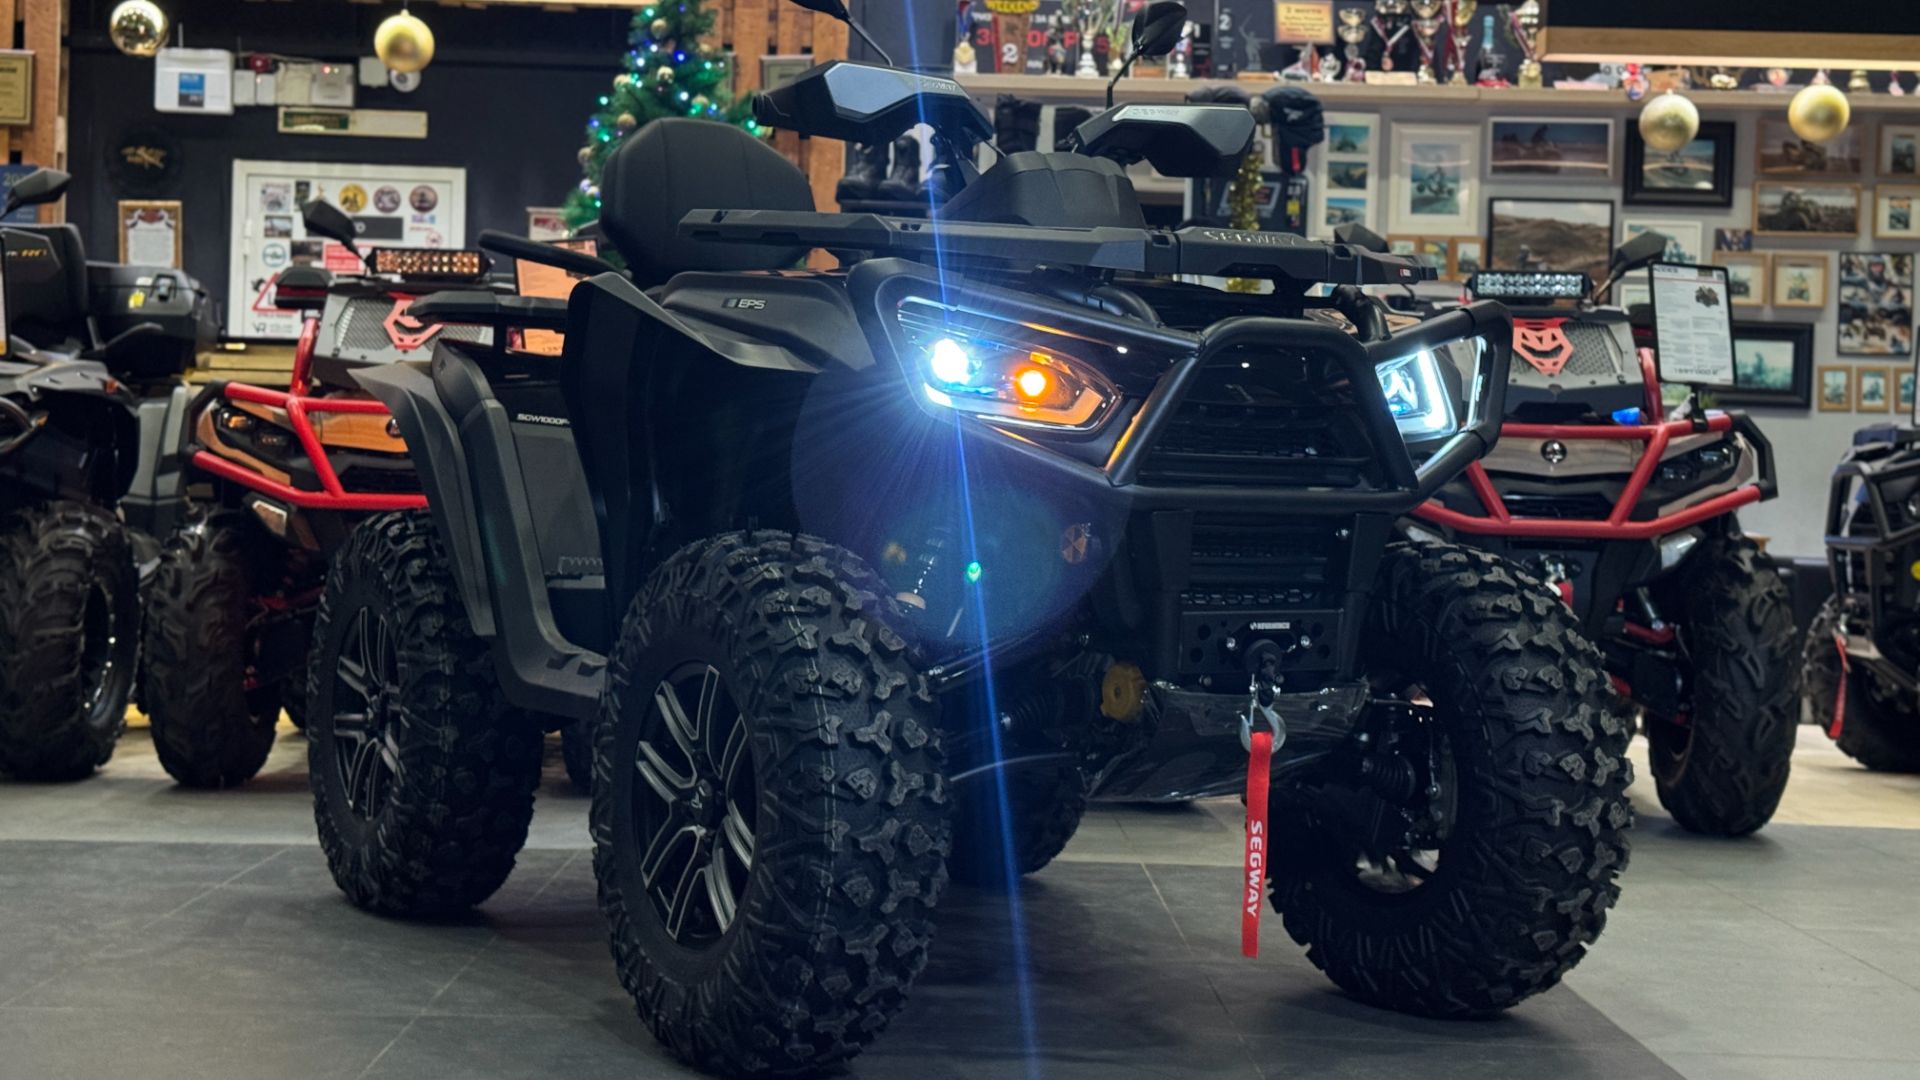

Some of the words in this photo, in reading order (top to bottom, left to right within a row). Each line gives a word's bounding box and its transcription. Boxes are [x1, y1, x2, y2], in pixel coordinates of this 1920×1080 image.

[1219, 14, 1231, 31] 2
[1002, 43, 1018, 64] 2
[738, 298, 767, 310] EPS
[1247, 819, 1263, 918] SEGWAY
